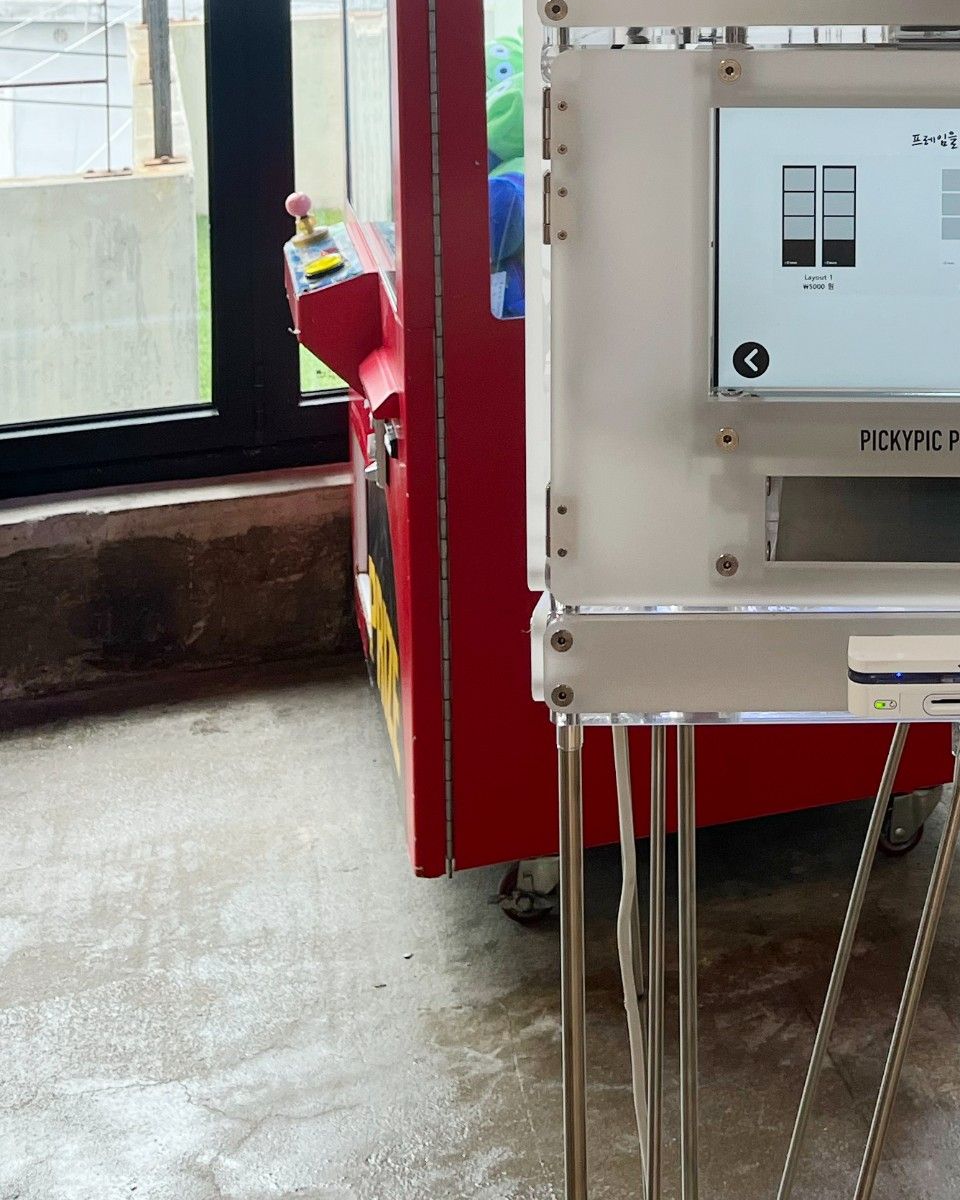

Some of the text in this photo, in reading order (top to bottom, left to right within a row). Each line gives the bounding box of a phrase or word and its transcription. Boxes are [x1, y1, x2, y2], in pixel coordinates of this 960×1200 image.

[911, 131, 958, 149] 프레임을
[804, 274, 827, 282] Layout
[860, 430, 943, 451] PICKYPIC
